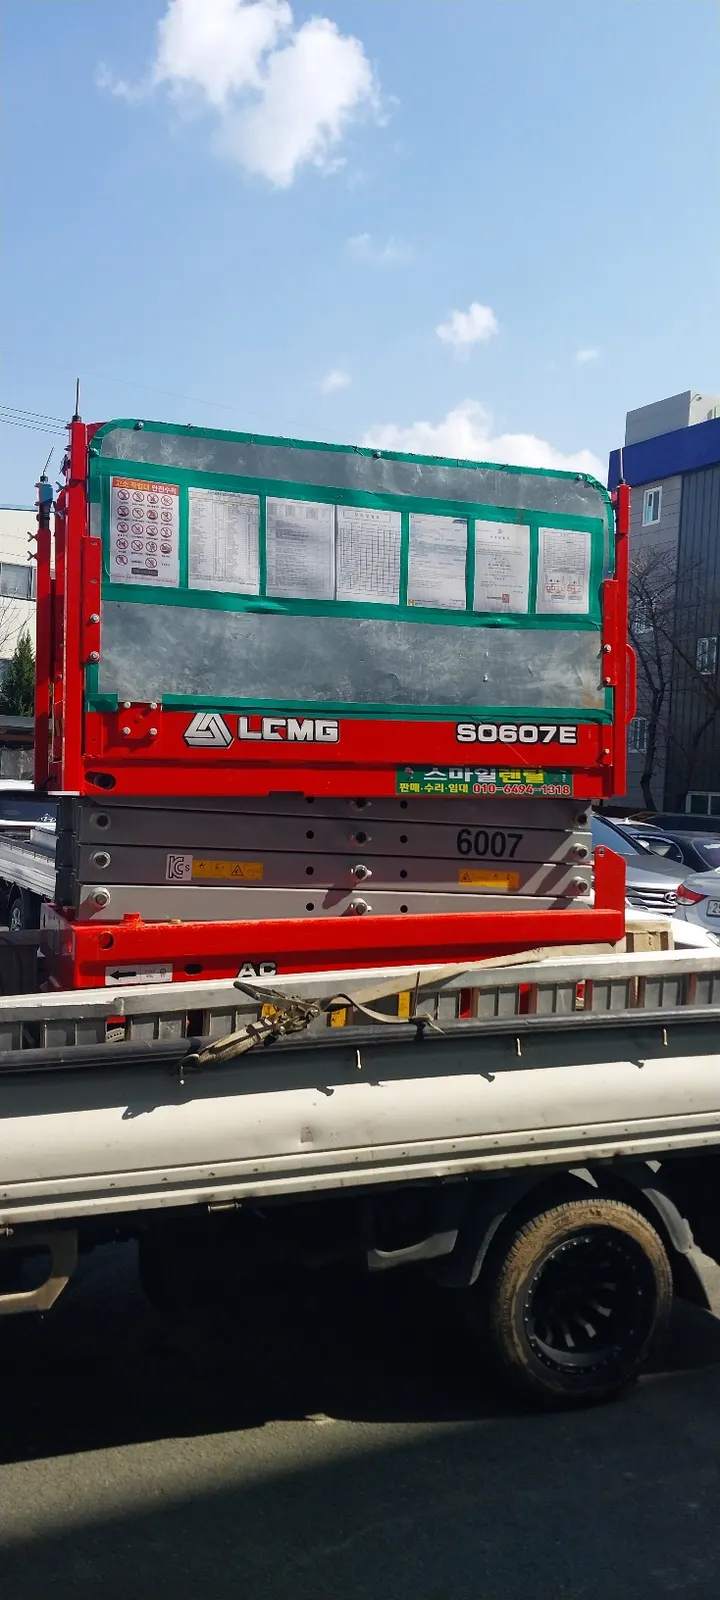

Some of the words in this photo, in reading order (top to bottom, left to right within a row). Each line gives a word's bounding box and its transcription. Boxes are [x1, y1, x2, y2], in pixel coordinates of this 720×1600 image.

[423, 767, 545, 784] 스마일렌탈
[472, 783, 571, 795] 010-6494-1318
[456, 828, 523, 858] 6007
[236, 961, 278, 978] AC
